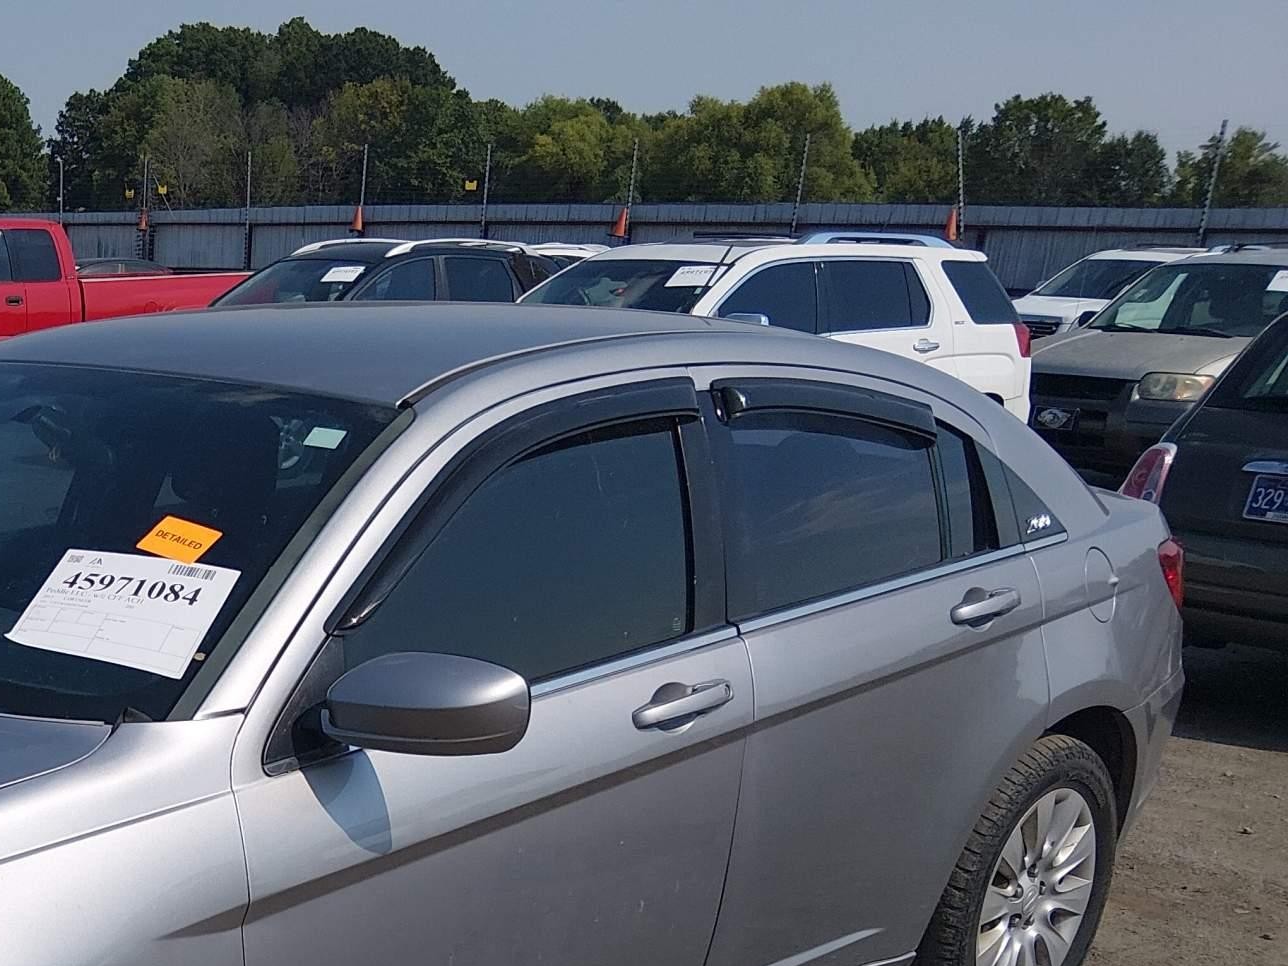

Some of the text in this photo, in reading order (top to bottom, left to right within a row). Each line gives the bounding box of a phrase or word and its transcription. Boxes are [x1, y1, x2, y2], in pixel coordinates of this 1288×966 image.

[1252, 488, 1284, 510] 329
[155, 529, 202, 550] DETAILED
[62, 571, 202, 606] 45971084
